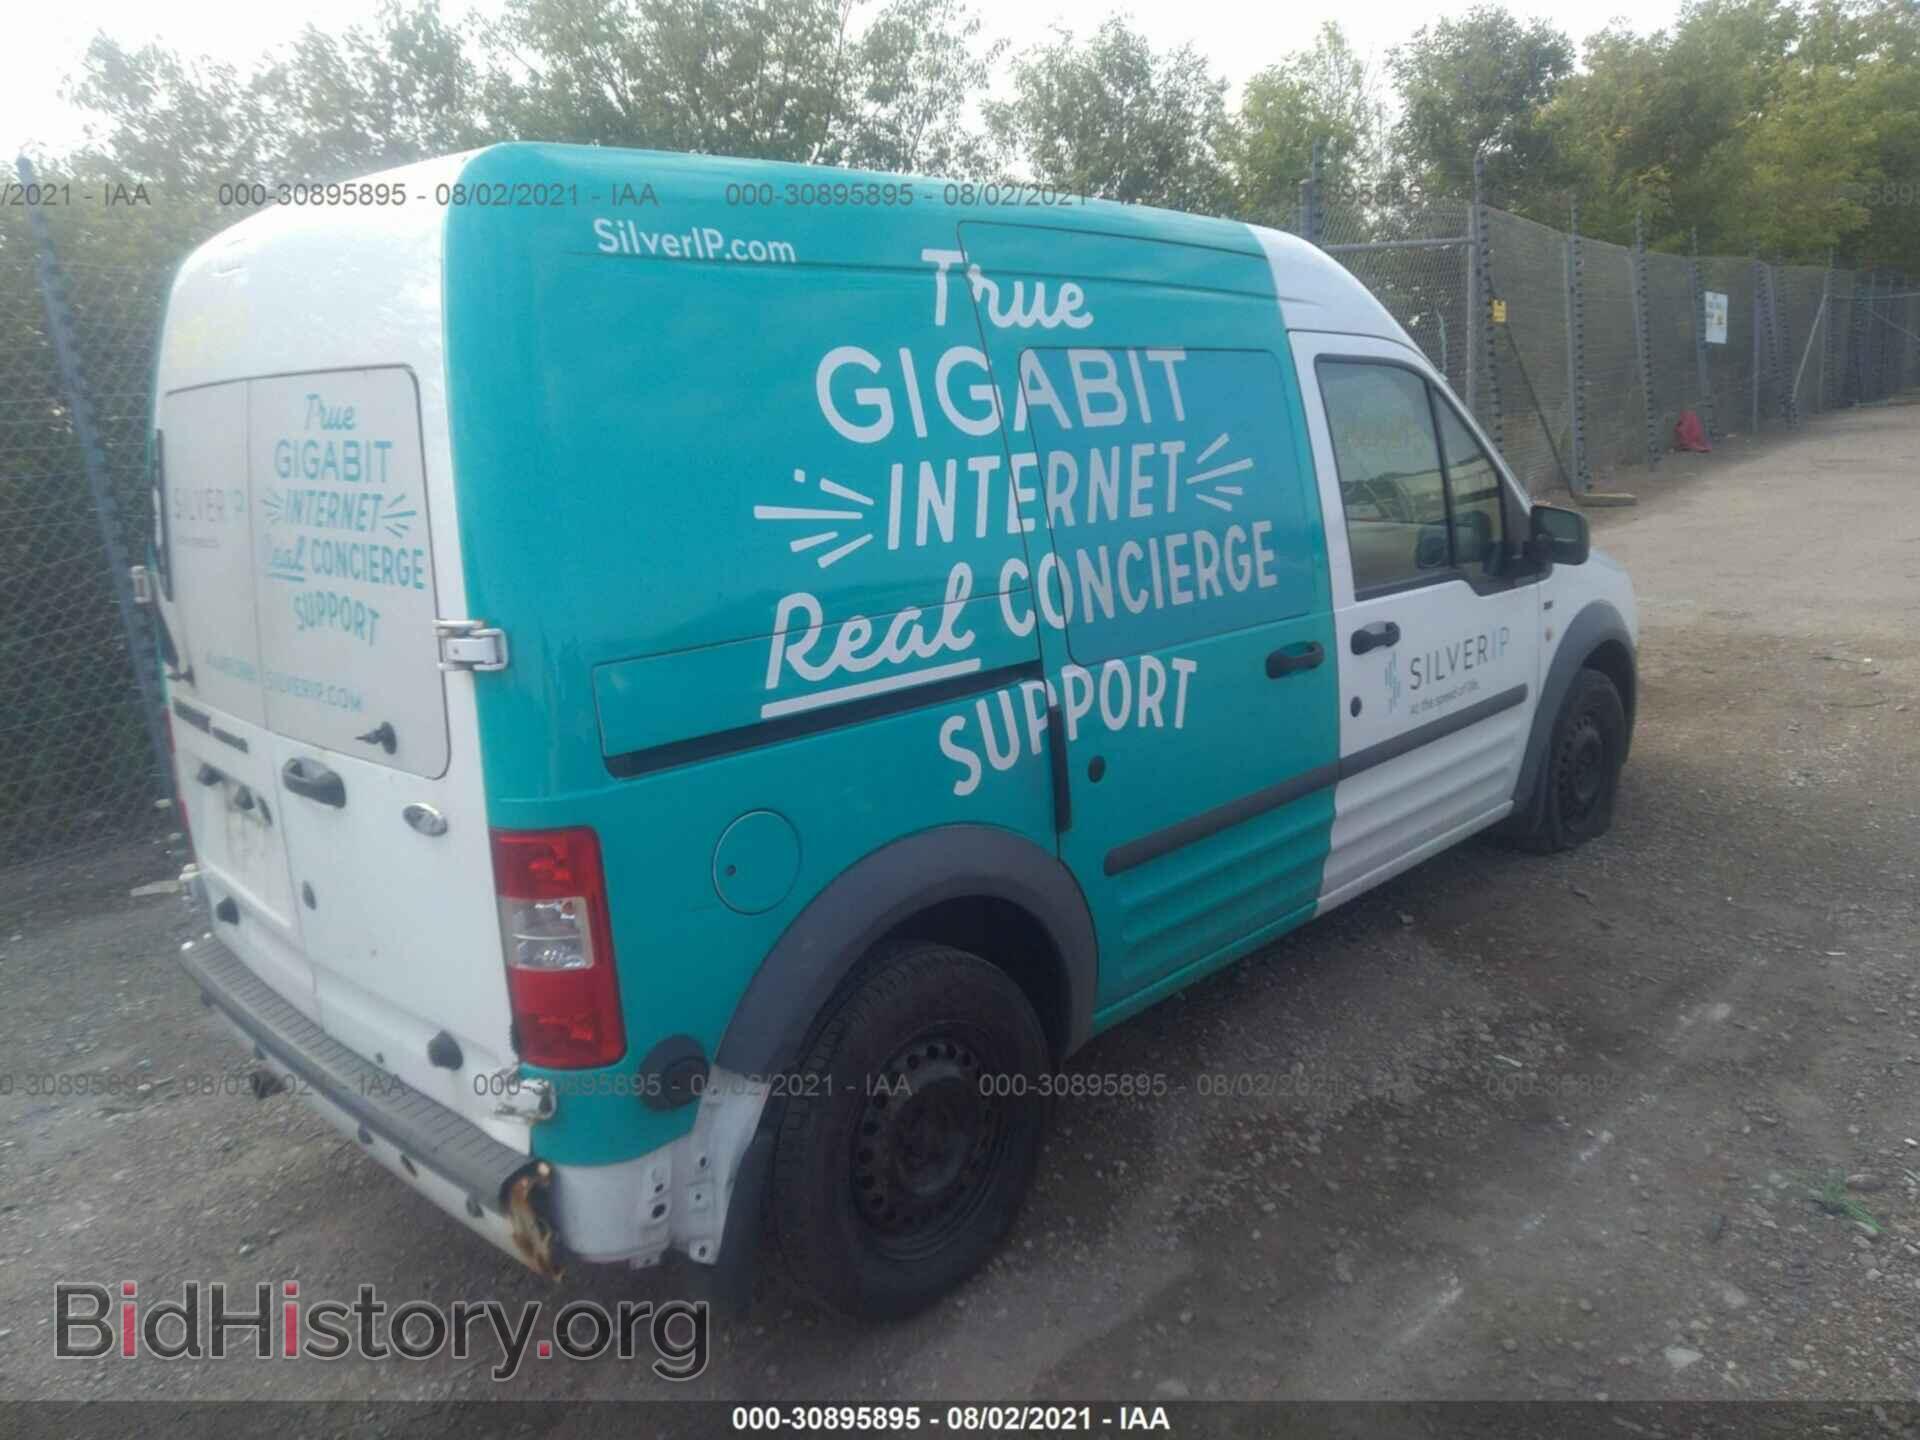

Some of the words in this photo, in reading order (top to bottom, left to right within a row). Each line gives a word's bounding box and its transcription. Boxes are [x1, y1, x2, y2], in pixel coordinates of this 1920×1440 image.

[593, 218, 797, 264] SilverIP.com
[921, 248, 1094, 329] True
[305, 393, 357, 431] True
[815, 345, 1187, 444] GIGABIT
[274, 438, 393, 483] GIGABIT
[286, 488, 384, 533] INTERNET
[888, 440, 1186, 550] INTERNET
[311, 538, 425, 590] CONCIERGE
[293, 590, 380, 647] SUPPORT
[764, 562, 976, 690] Real
[999, 520, 1278, 637] CONCIERGE
[1409, 625, 1511, 691] SILVERIP
[939, 655, 1198, 796] SUPPORT
